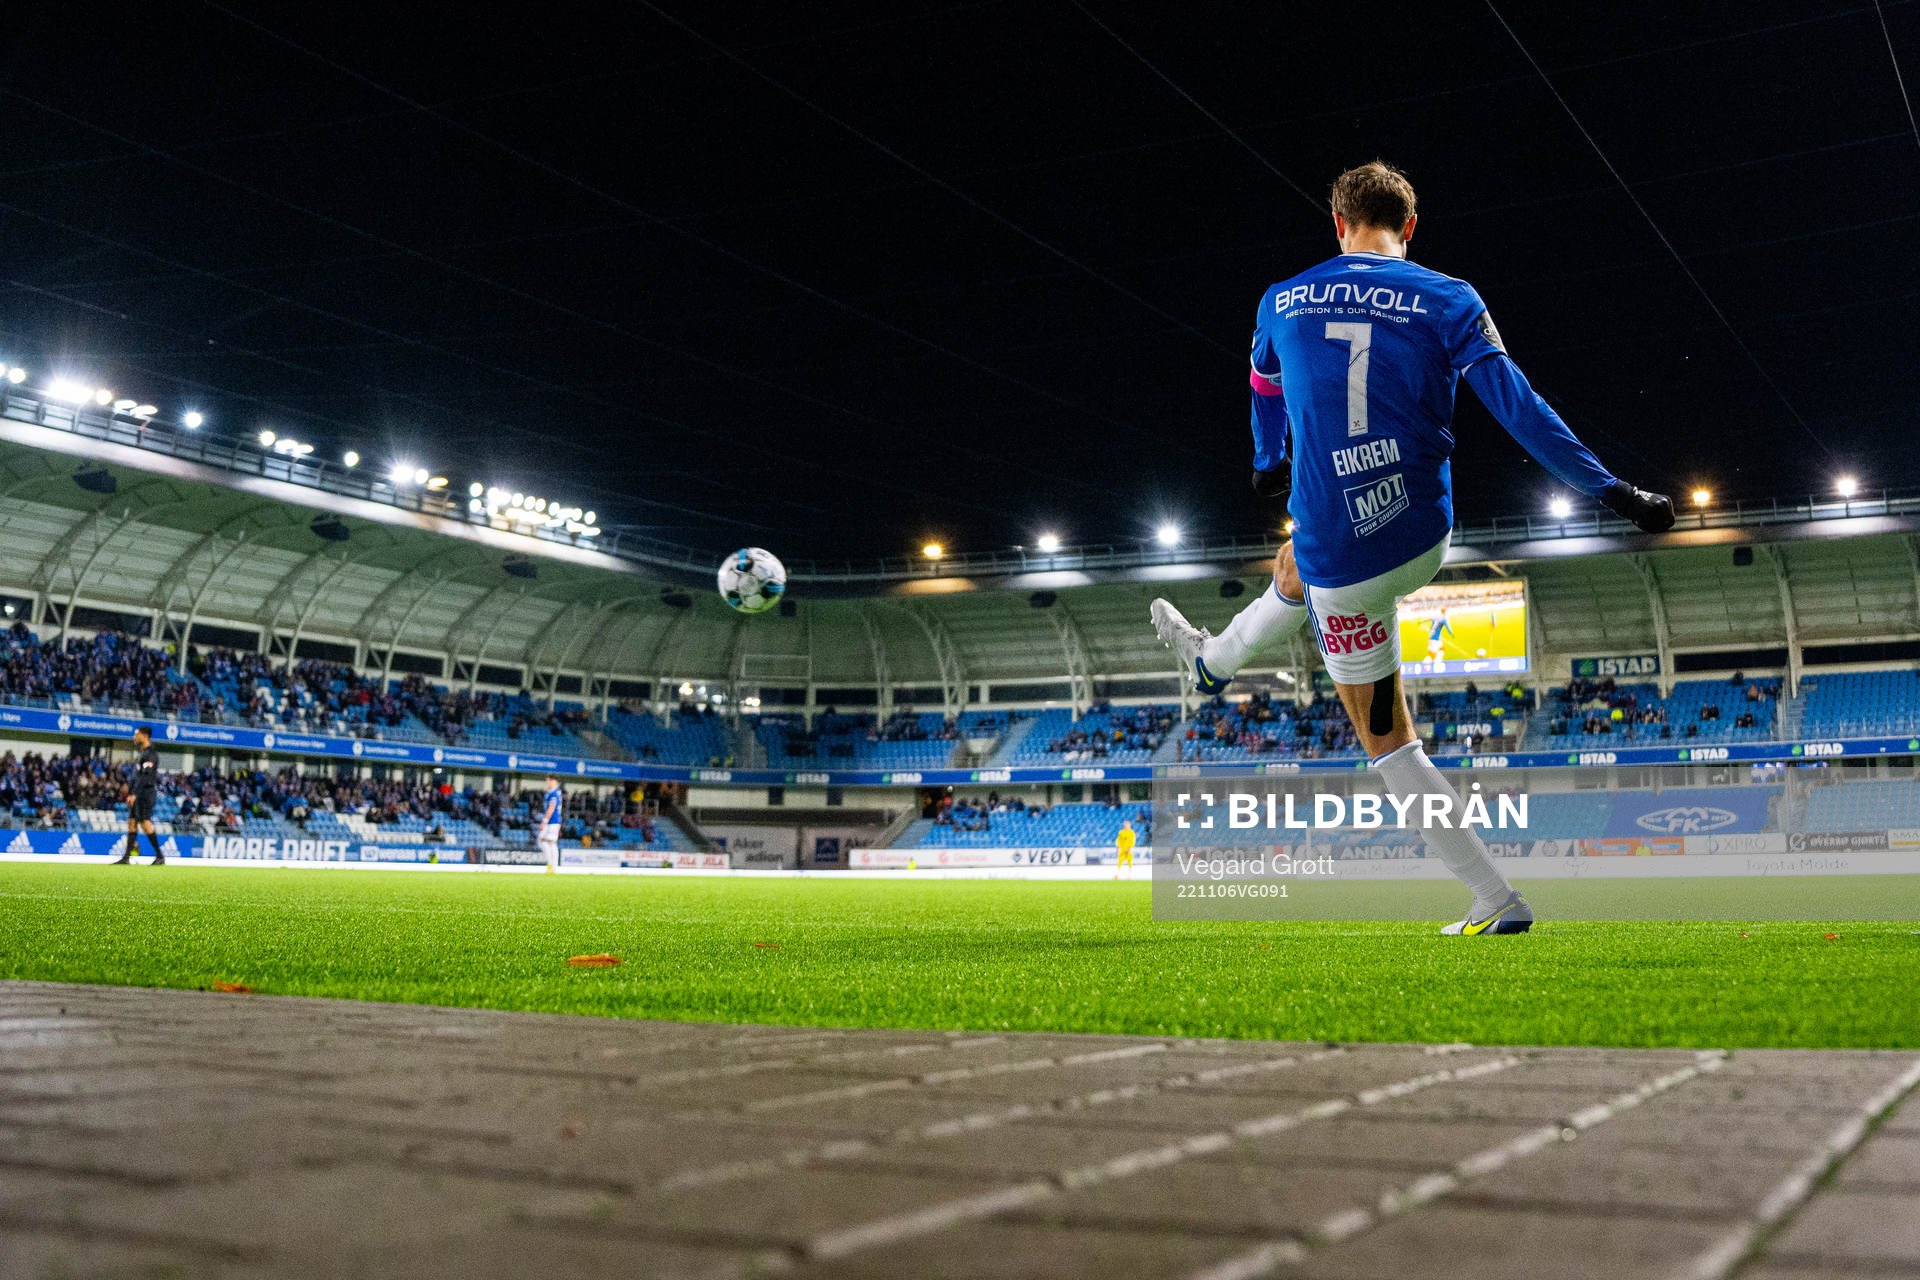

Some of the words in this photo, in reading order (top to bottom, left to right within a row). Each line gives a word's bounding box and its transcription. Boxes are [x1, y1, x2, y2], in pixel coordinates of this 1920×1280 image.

[1275, 283, 1427, 314] BRUNVOLL
[1285, 307, 1331, 319] PRECISION
[1347, 307, 1367, 315] OUR
[1370, 309, 1410, 323] PASSION
[1325, 321, 1372, 437] 7
[1332, 438, 1400, 477] EIKREM
[1355, 474, 1402, 519] MOT
[1324, 620, 1388, 654] BYGG
[1598, 657, 1656, 675] ISTAD
[1690, 748, 1728, 760] ISTAD
[1804, 743, 1843, 756] ISTAD
[1472, 756, 1508, 768] ISTAD
[1579, 753, 1617, 765] ISTAD
[892, 772, 922, 783] ISTAD
[1072, 768, 1105, 780] ISTAD
[281, 839, 349, 861] DRIFT
[1028, 850, 1074, 864] VEØY
[1340, 845, 1418, 859] ANGVIK
